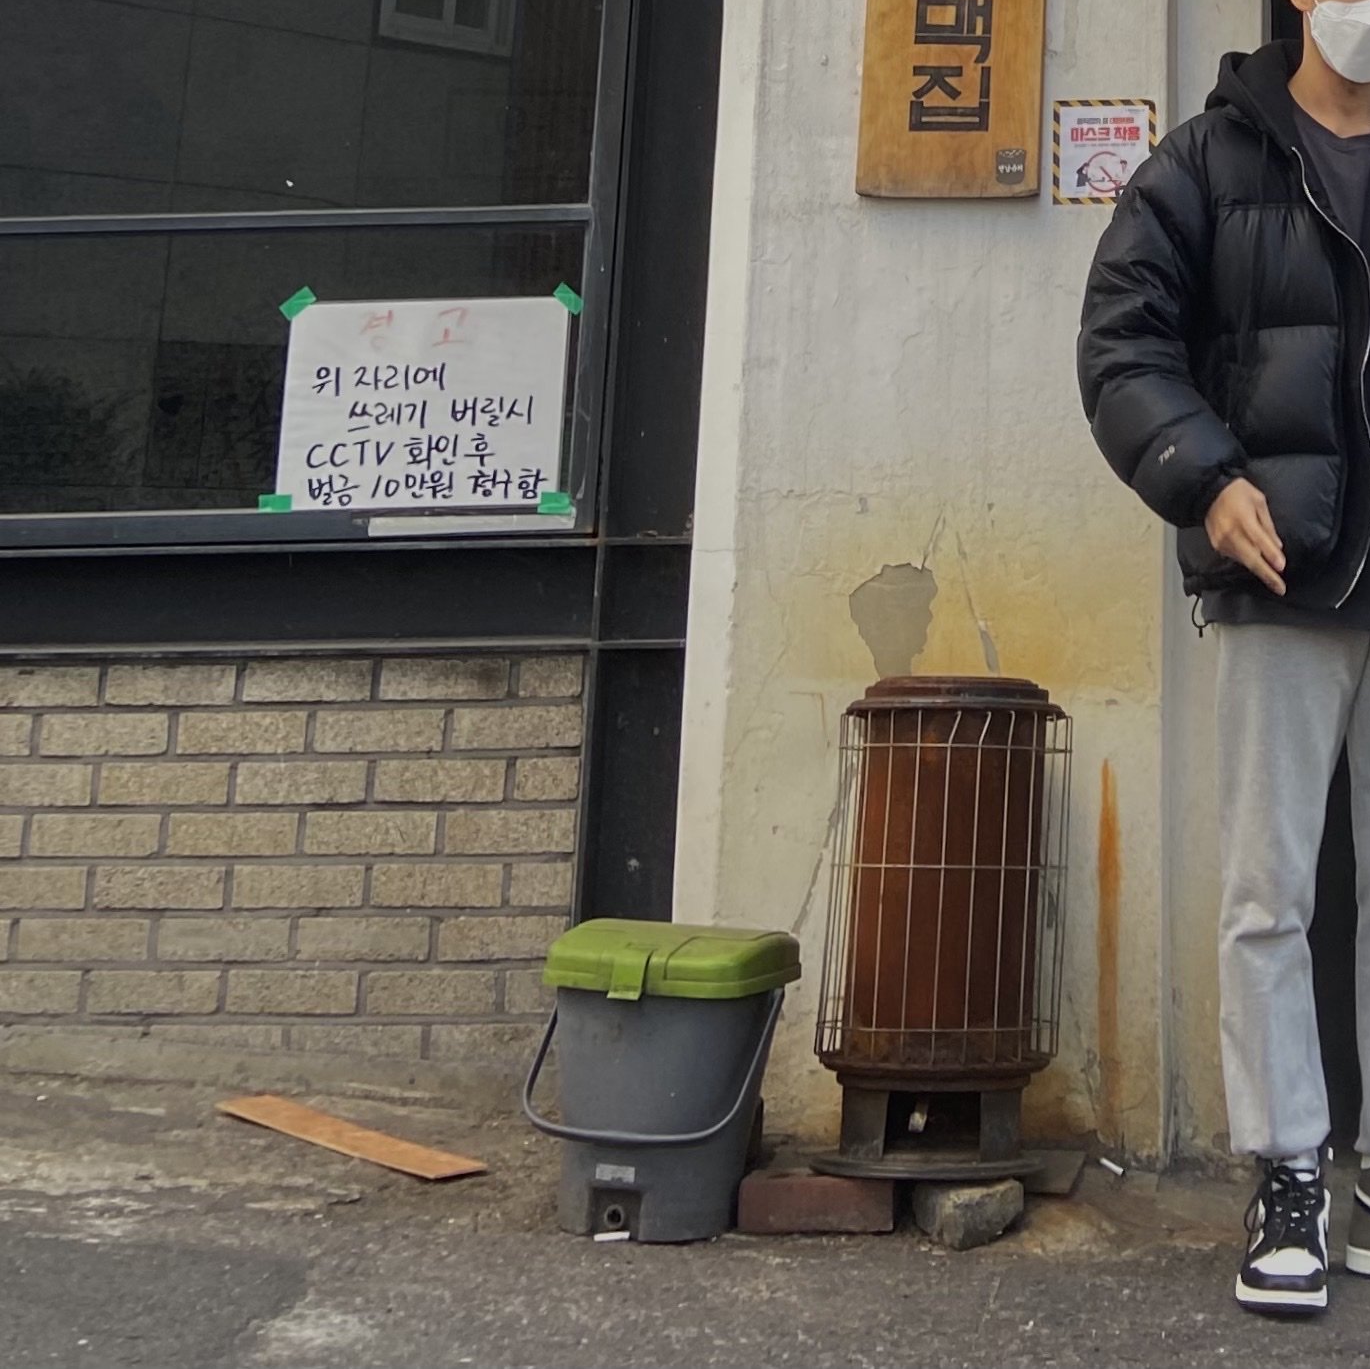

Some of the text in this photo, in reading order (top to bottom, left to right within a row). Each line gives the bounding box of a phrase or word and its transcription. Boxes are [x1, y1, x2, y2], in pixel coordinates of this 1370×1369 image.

[1071, 126, 1141, 143] 마스크 착용
[311, 362, 446, 397] 위 자리에
[347, 399, 428, 433] 쓰레기
[305, 439, 395, 469] CCTV
[307, 474, 359, 507] 벌금
